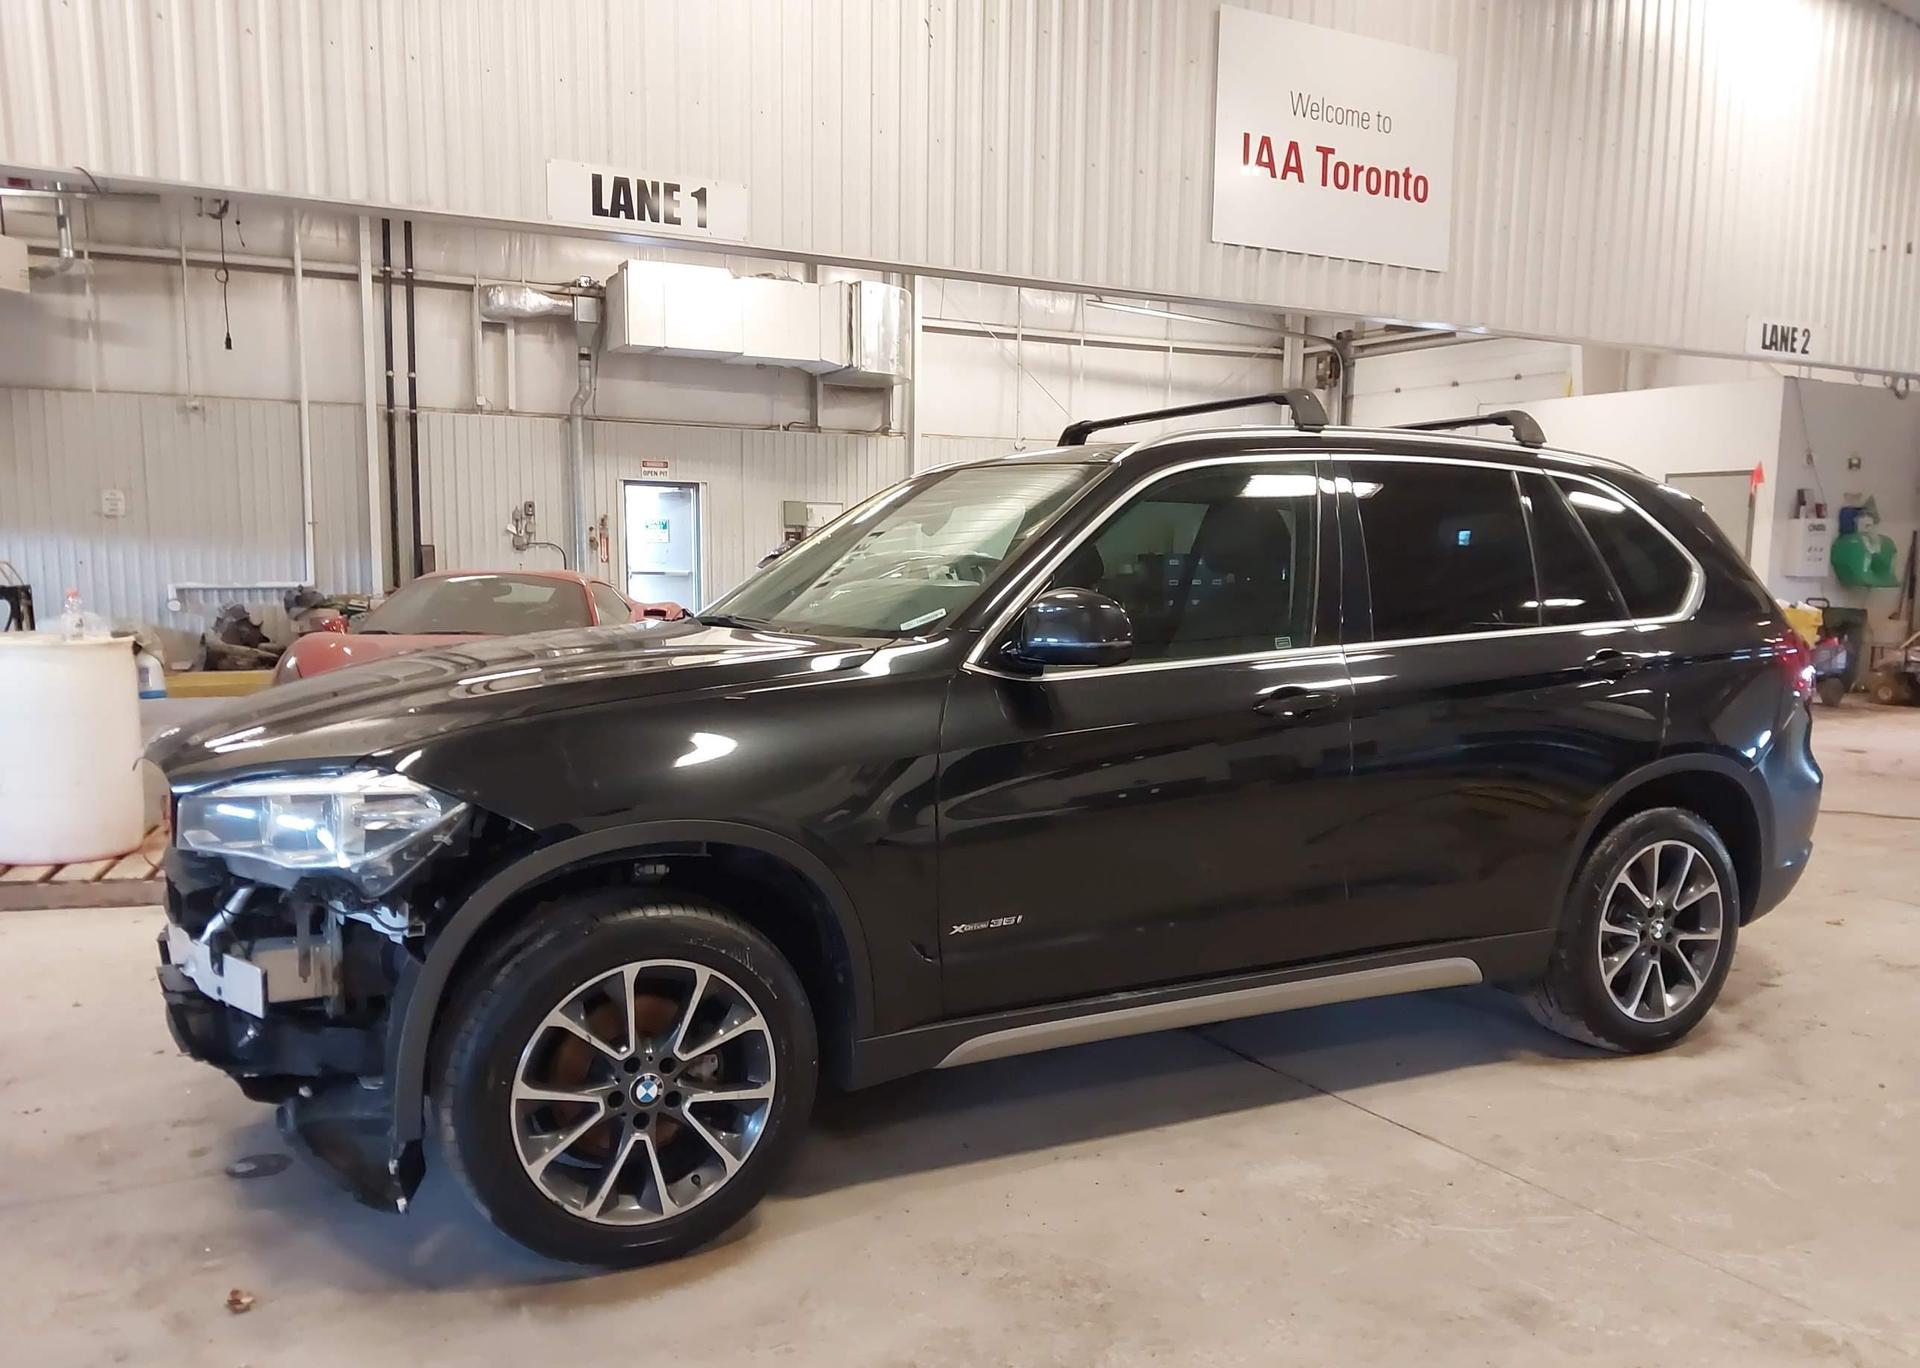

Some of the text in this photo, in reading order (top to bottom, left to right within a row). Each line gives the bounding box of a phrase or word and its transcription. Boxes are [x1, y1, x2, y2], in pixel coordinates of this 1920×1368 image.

[1290, 91, 1392, 134] Welcome to
[1243, 132, 1429, 204] IAA Toronto
[592, 173, 708, 229] LANE 1
[1761, 323, 1811, 355] LANE 2
